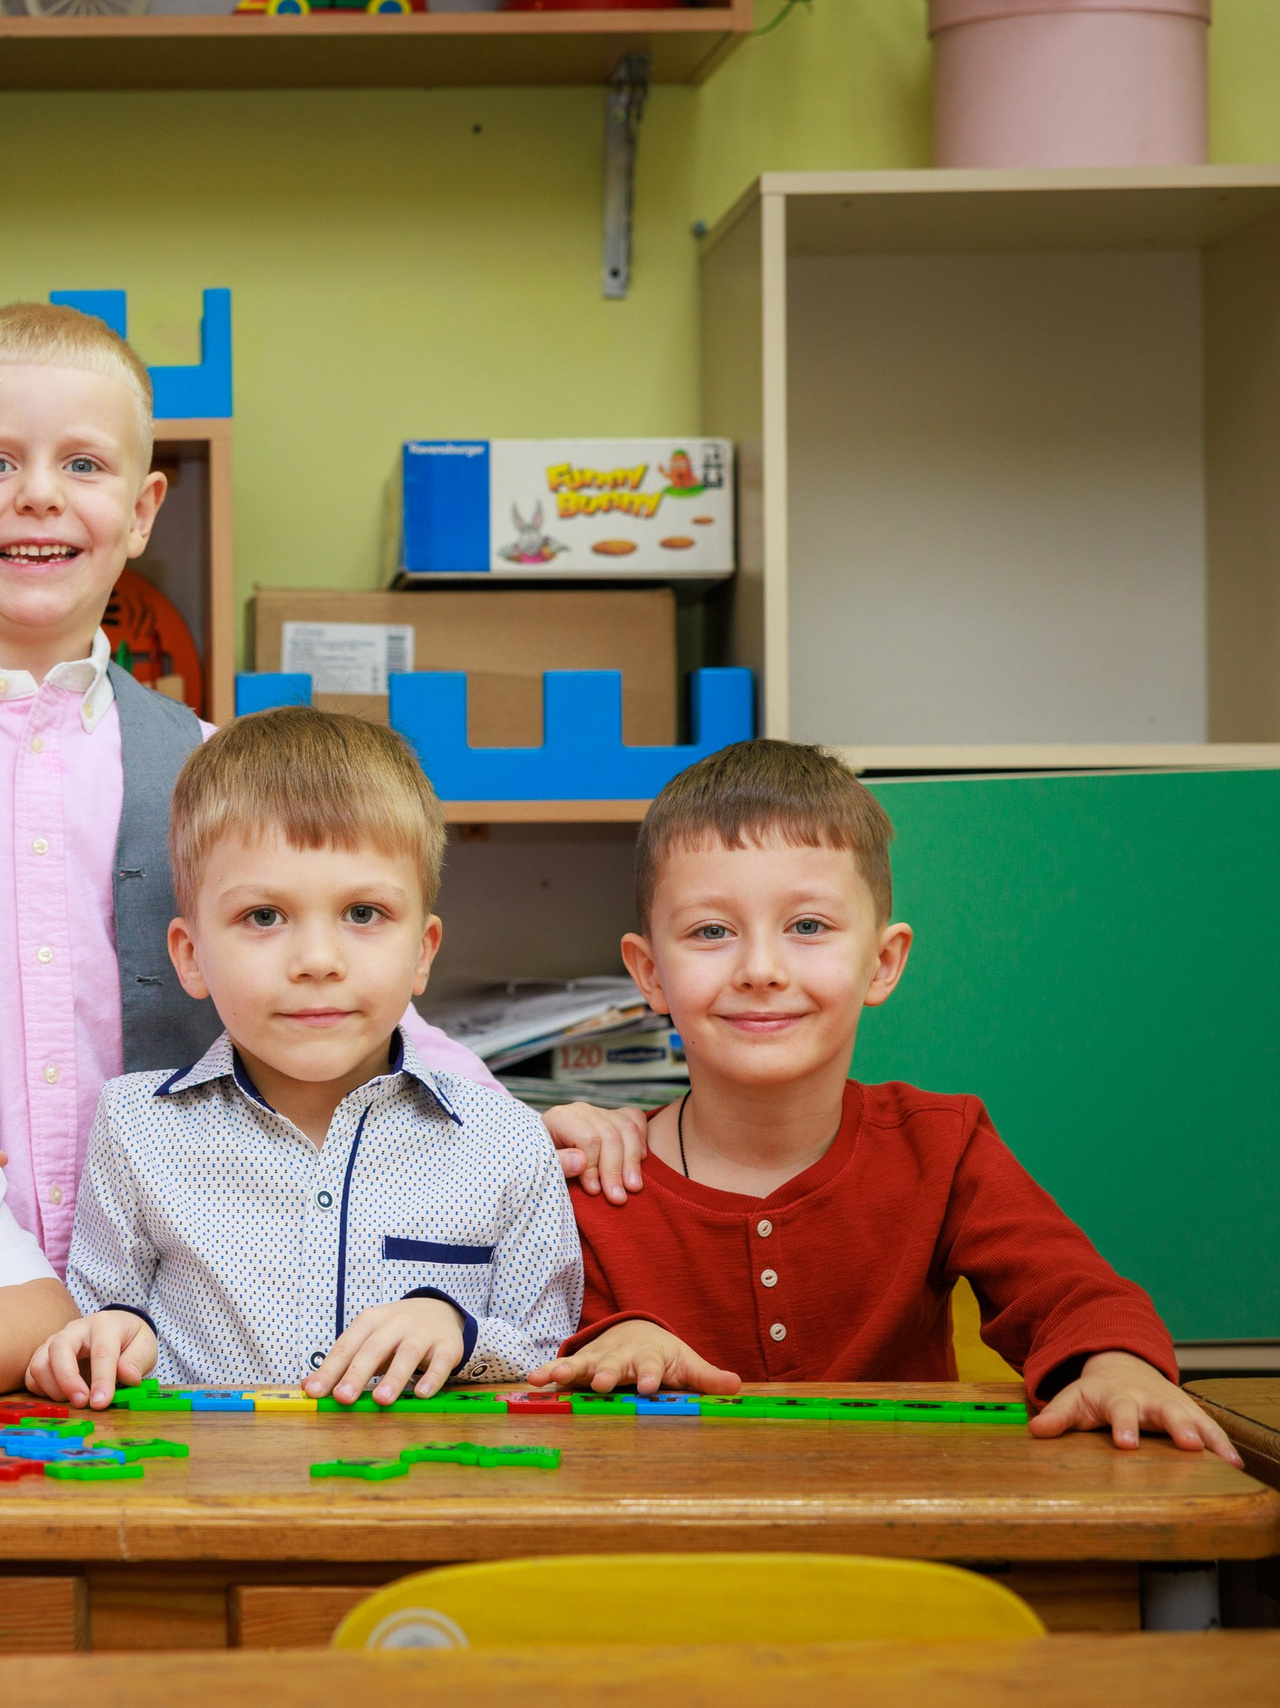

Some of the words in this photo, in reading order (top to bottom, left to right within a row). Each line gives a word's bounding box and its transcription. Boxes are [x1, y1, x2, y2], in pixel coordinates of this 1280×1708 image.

[547, 463, 647, 491] Funny
[557, 490, 663, 518] Bunny
[562, 1045, 603, 1069] 120
